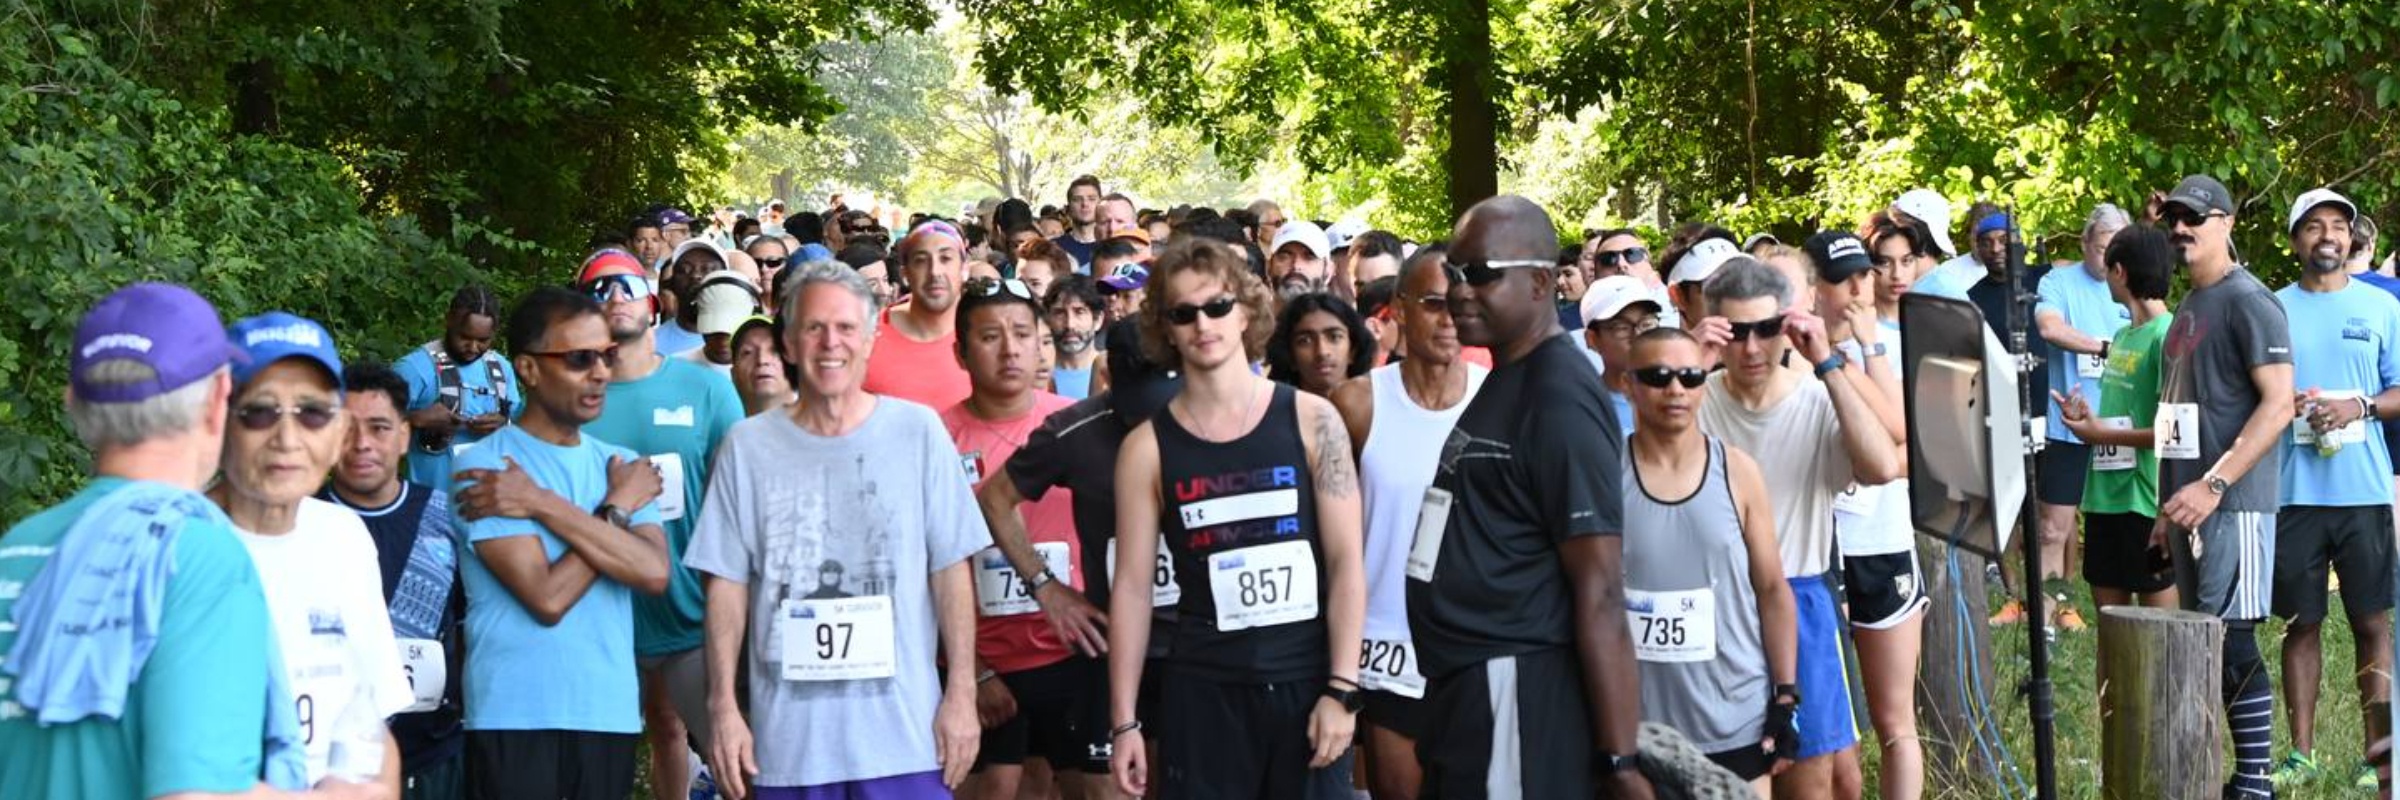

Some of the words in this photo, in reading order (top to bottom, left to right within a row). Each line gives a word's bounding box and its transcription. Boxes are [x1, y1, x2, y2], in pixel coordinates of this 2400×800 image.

[1176, 465, 1297, 500] UNDER
[1238, 565, 1293, 607] 857
[1681, 597, 1696, 613] 5K
[816, 622, 854, 660] 97
[1639, 616, 1686, 647] 735
[408, 644, 424, 661] 5K
[1359, 638, 1406, 678] 820
